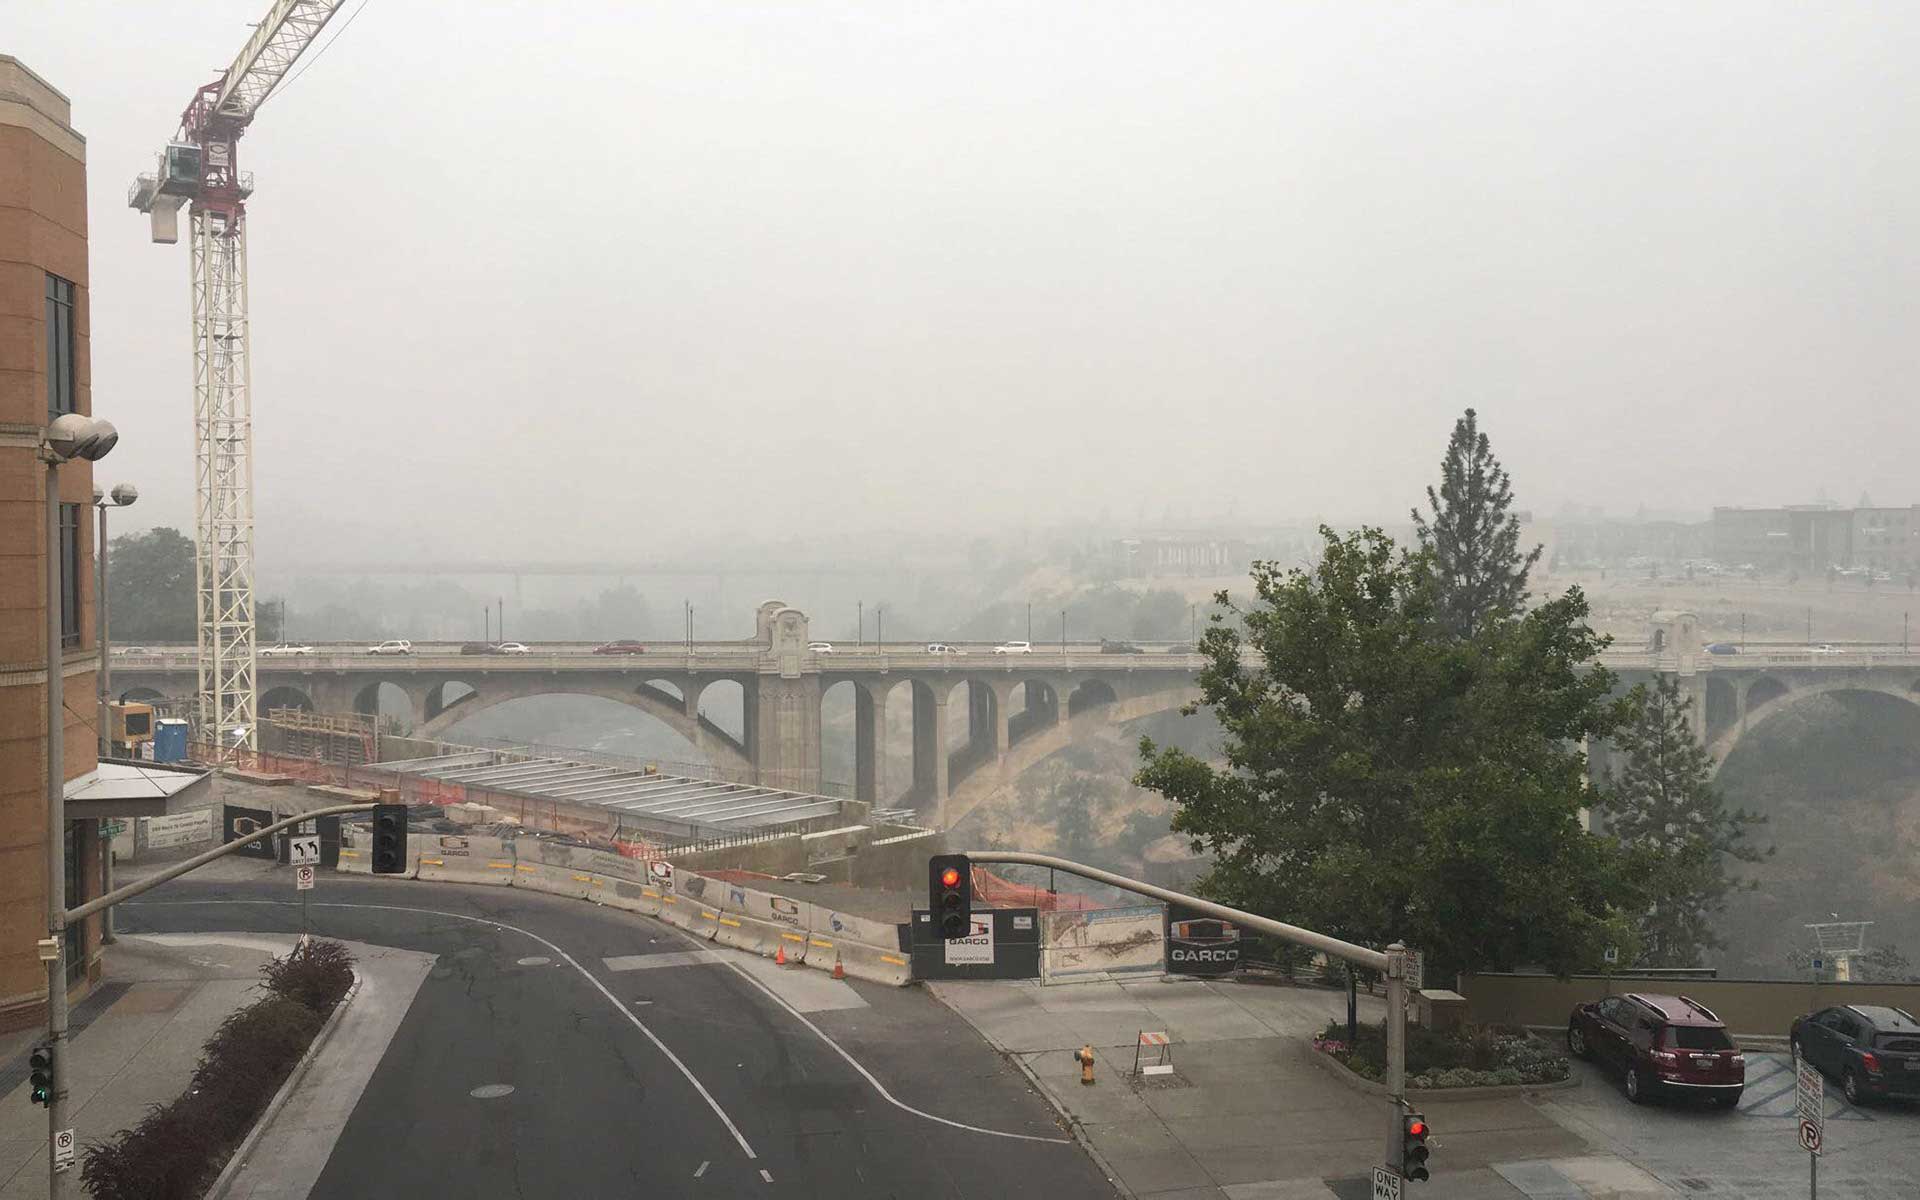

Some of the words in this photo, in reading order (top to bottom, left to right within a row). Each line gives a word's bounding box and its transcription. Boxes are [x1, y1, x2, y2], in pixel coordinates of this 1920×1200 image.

[771, 912, 799, 926] GARCO
[949, 938, 989, 946] GARCO
[1171, 949, 1239, 962] GARCO
[1376, 1171, 1398, 1189] ONE
[1375, 1184, 1399, 1200] WAY
